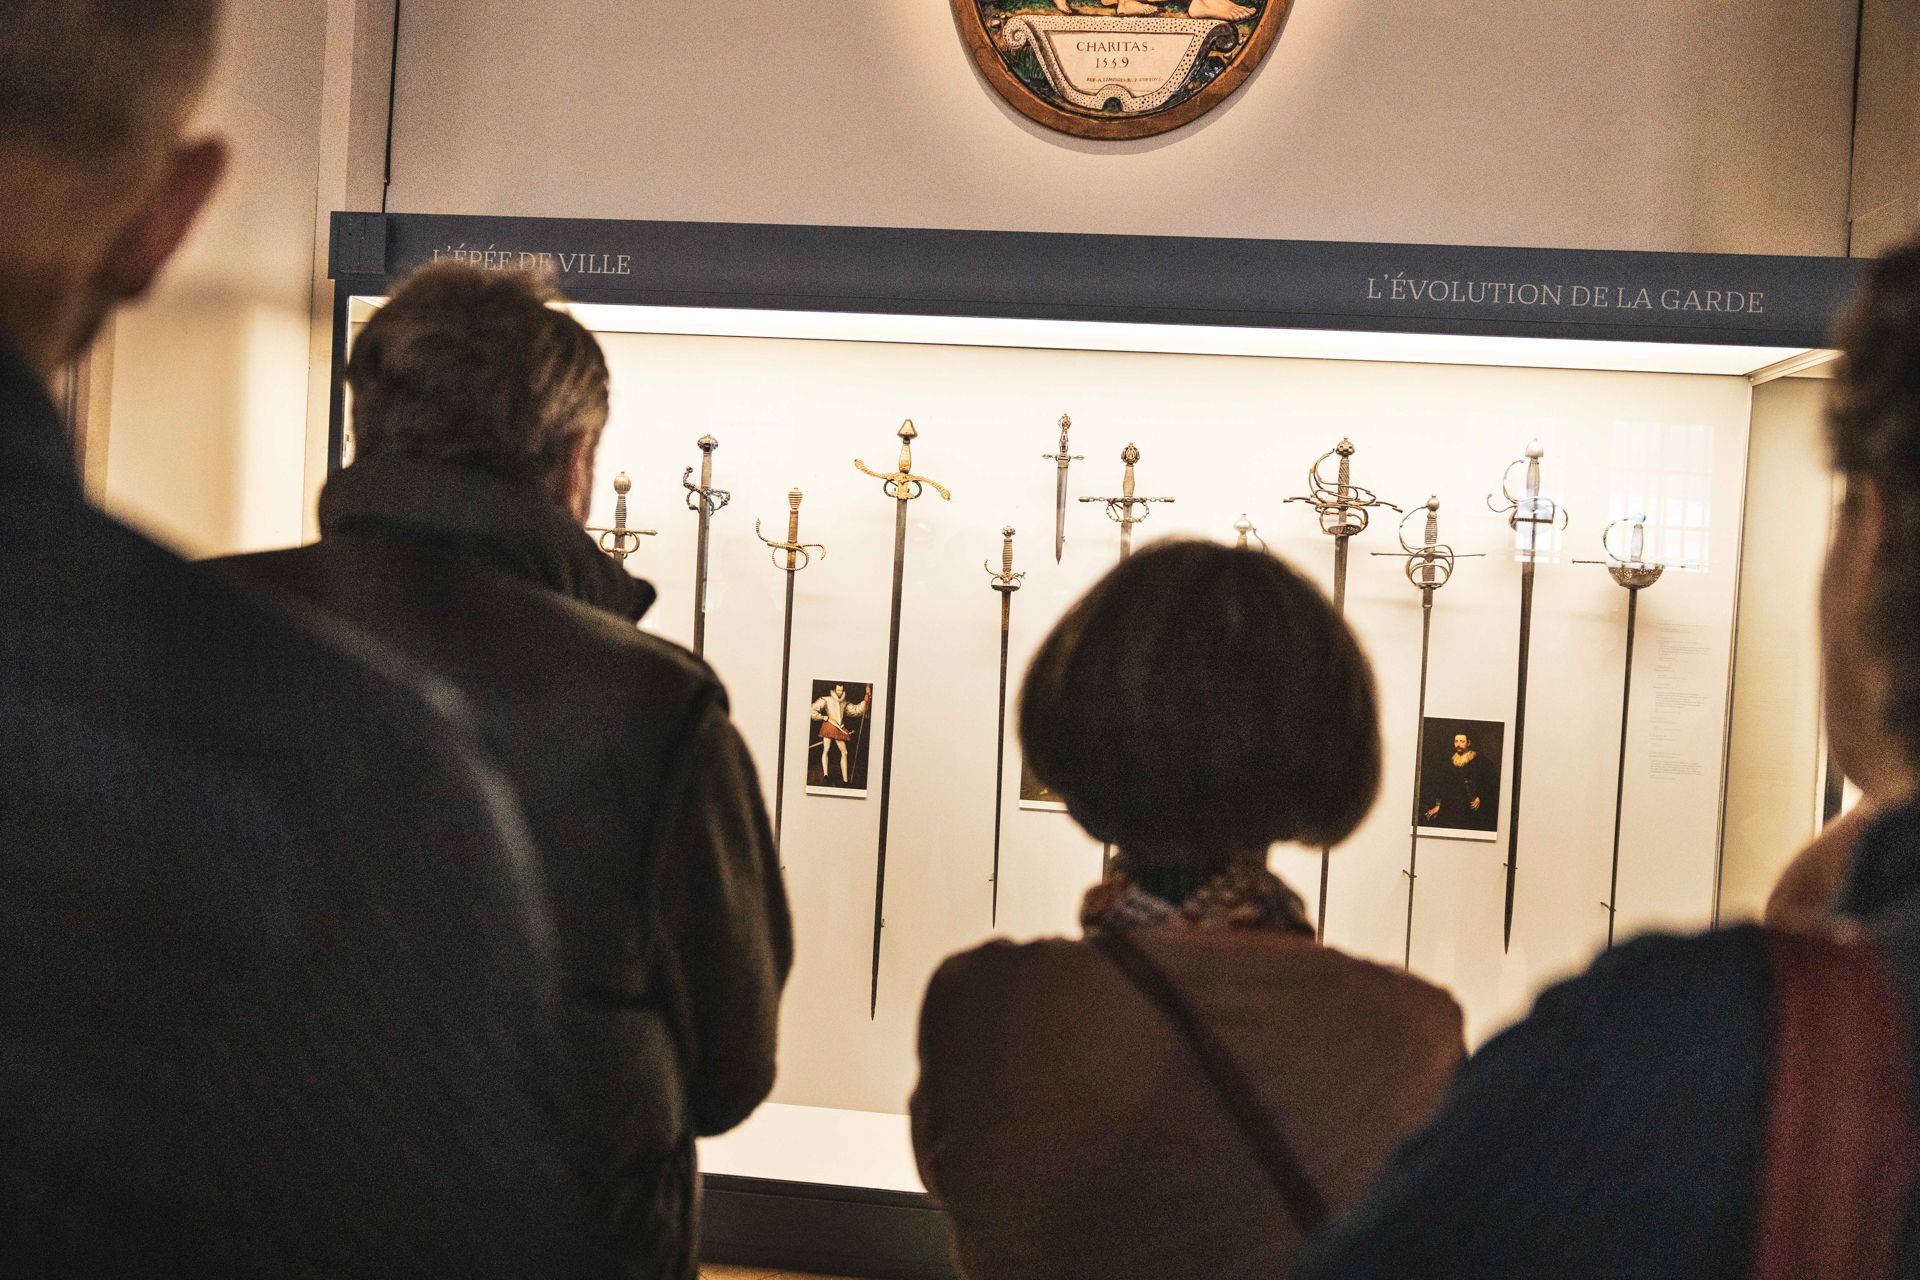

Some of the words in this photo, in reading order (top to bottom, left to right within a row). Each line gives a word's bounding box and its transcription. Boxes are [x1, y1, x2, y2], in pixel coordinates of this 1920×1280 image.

[1095, 56, 1129, 69] 1559
[558, 252, 631, 275] VILLE
[1366, 271, 1563, 306] L'ÉVOLUTION
[1570, 285, 1609, 308] DE
[1615, 287, 1654, 309] LA
[1660, 288, 1764, 313] GARDE
